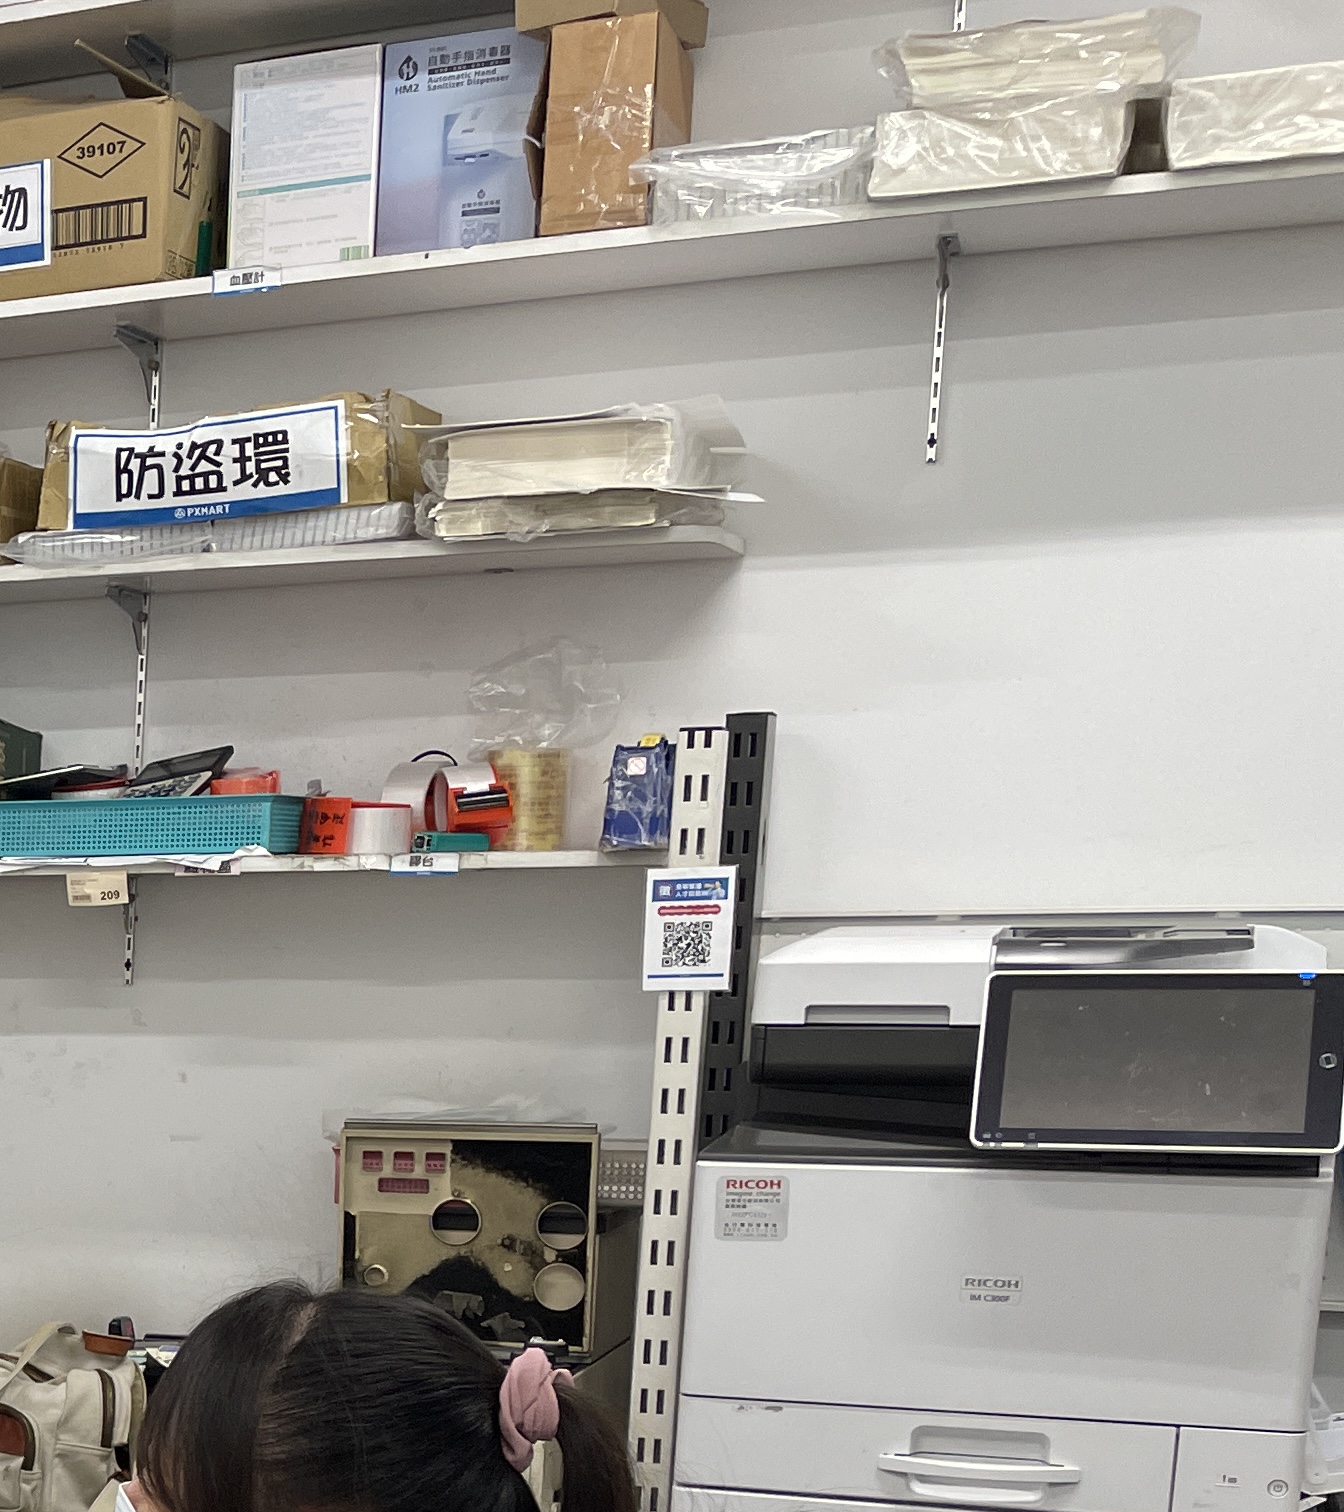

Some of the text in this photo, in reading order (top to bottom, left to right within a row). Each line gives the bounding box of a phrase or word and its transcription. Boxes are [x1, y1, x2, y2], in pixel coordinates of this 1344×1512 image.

[426, 74, 510, 92] Sanitizer Dispenser
[427, 67, 497, 84] Automatic Hand
[76, 140, 126, 160] 39107
[115, 430, 291, 503] 防盜環
[186, 503, 231, 517] PXMART
[100, 890, 120, 901] 209
[726, 1180, 781, 1189] RICOH
[965, 1278, 1019, 1288] RICOH
